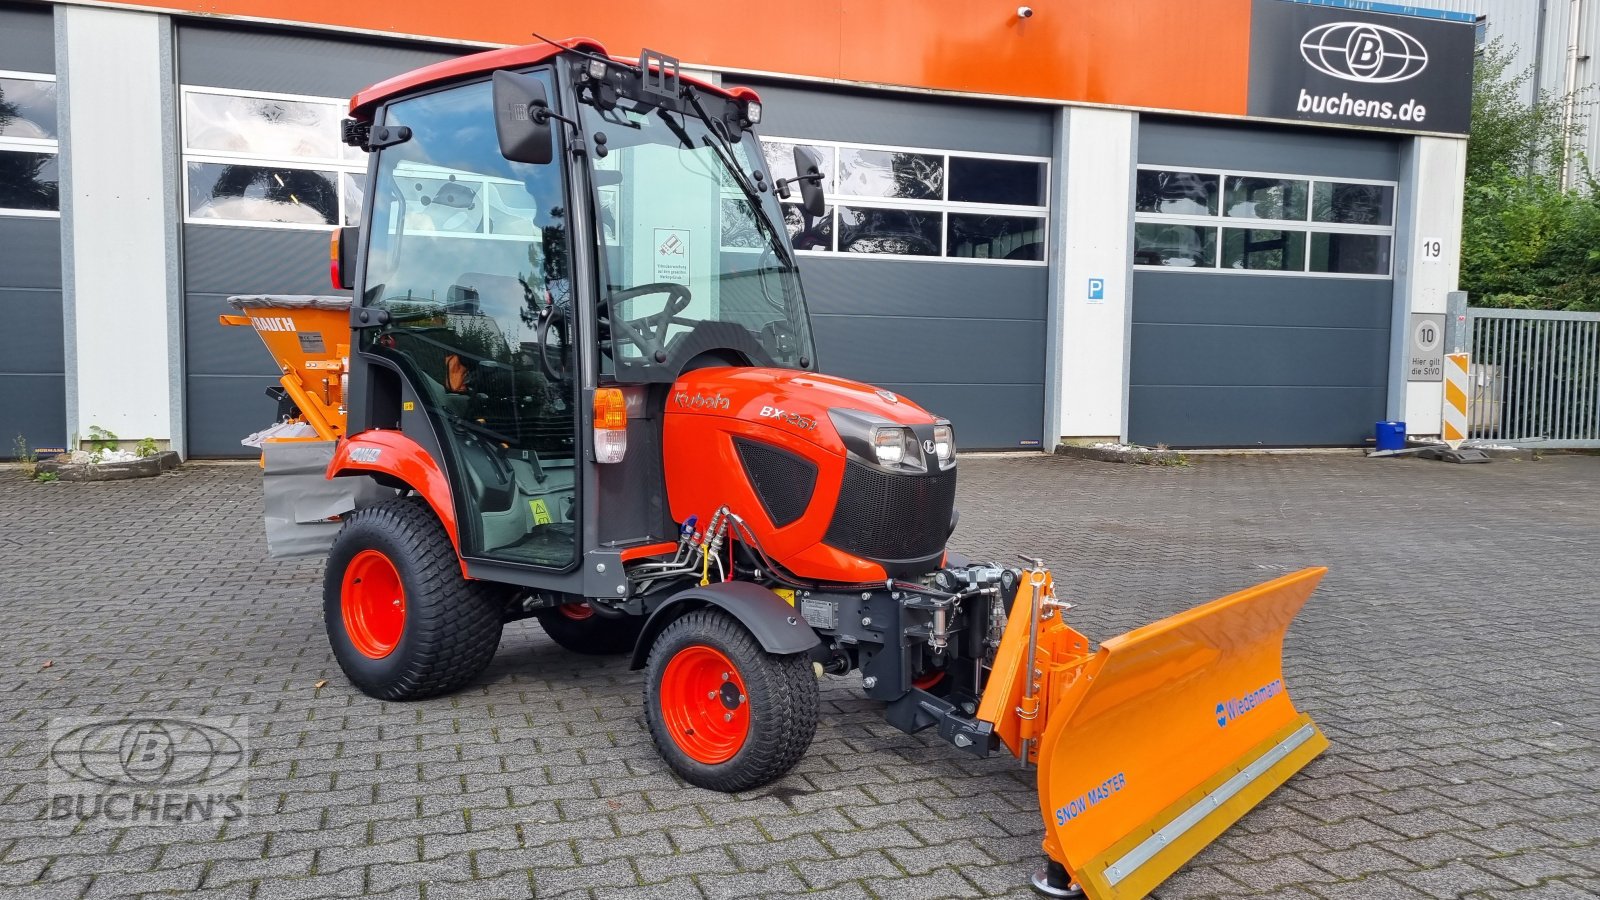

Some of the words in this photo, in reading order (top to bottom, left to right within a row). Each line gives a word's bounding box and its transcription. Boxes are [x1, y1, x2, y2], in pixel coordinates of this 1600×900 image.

[1297, 89, 1426, 122] buchens.de
[1423, 241, 1441, 257] 19
[1090, 280, 1102, 298] P
[252, 317, 296, 331] RAUCH
[1421, 328, 1434, 342] 10
[1412, 358, 1426, 366] Hier
[1429, 358, 1440, 367] gilt
[1411, 367, 1421, 376] die
[1423, 367, 1440, 376] StVO
[674, 391, 730, 409] Kubota
[1225, 679, 1283, 721] Wiedenmann
[1056, 795, 1087, 827] SNOW
[1088, 772, 1126, 807] MASTER
